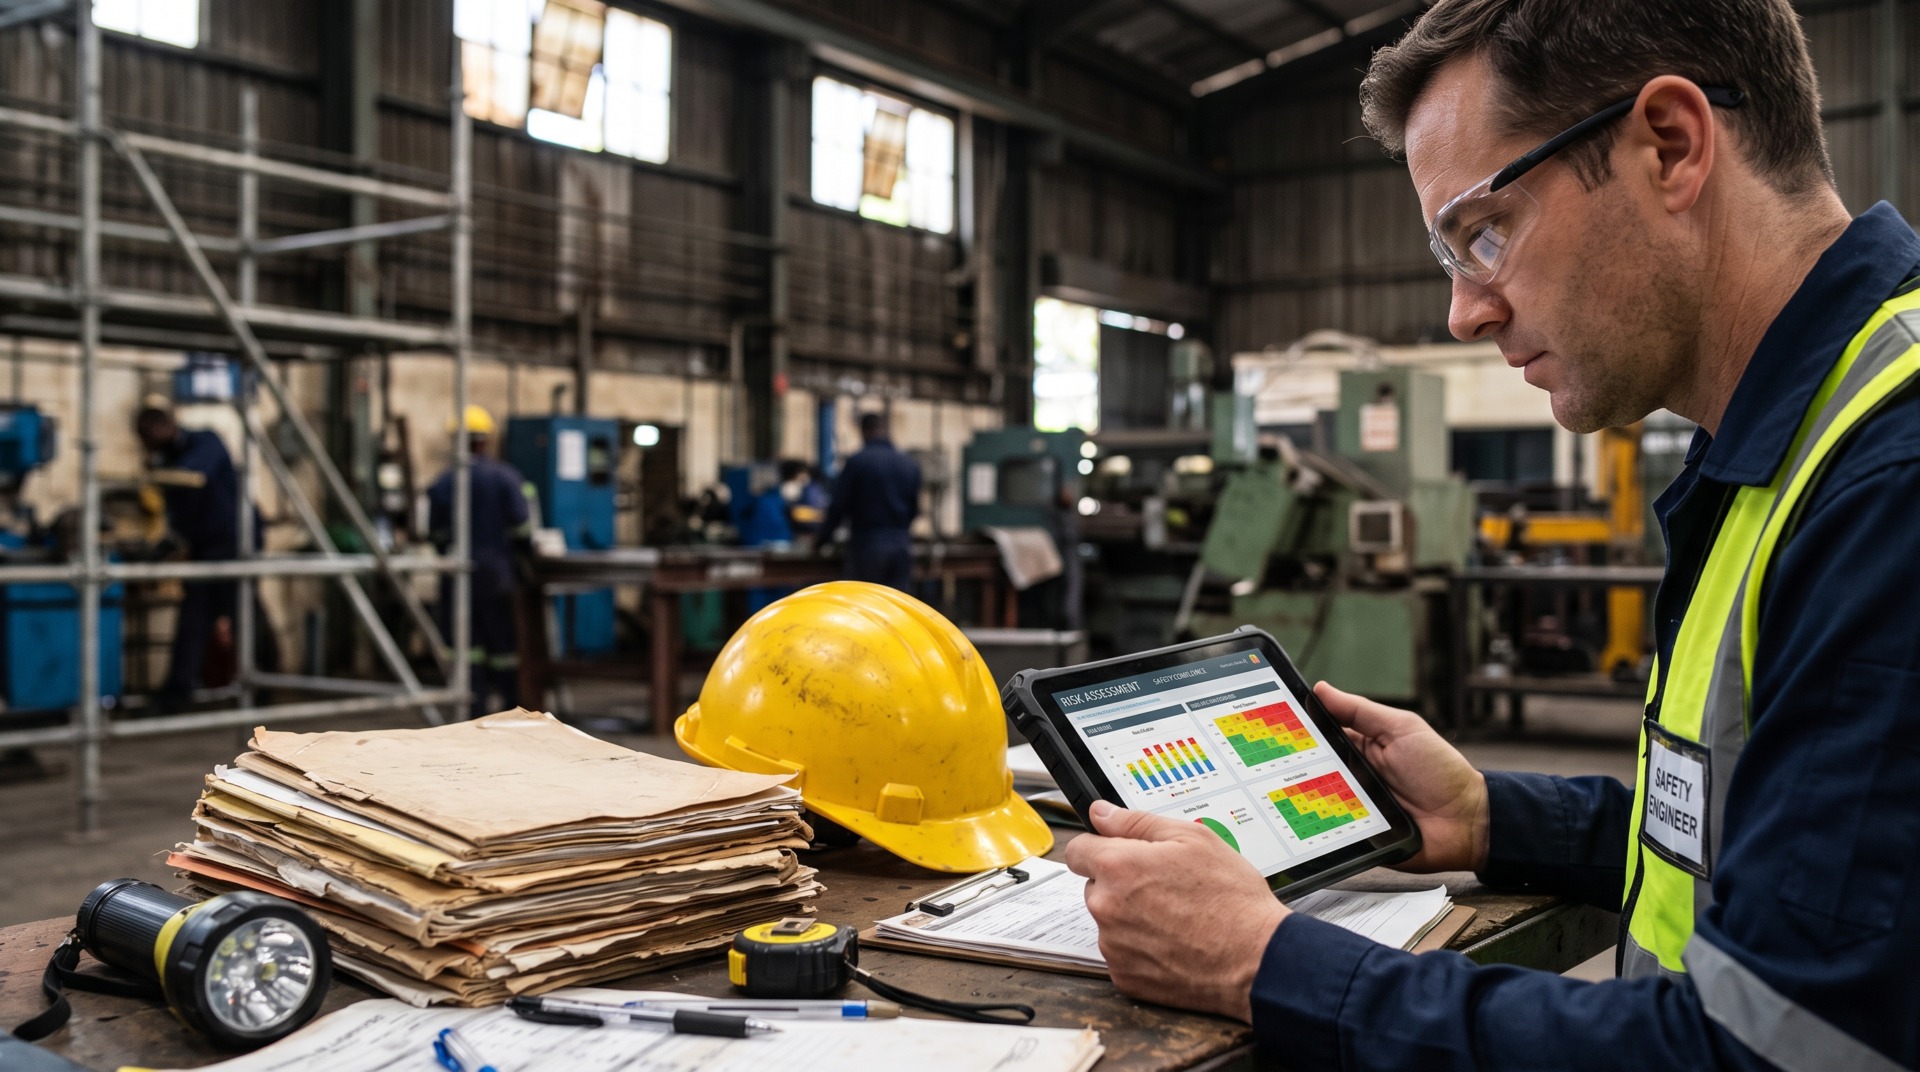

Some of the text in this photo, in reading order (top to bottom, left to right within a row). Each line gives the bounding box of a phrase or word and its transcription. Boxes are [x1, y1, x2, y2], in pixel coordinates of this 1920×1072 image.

[1060, 681, 1141, 707] RISK ASSESSMENT
[1152, 674, 1174, 685] SAFETY
[1655, 767, 1693, 803] SAFETY
[1648, 795, 1698, 839] ENGINEER
